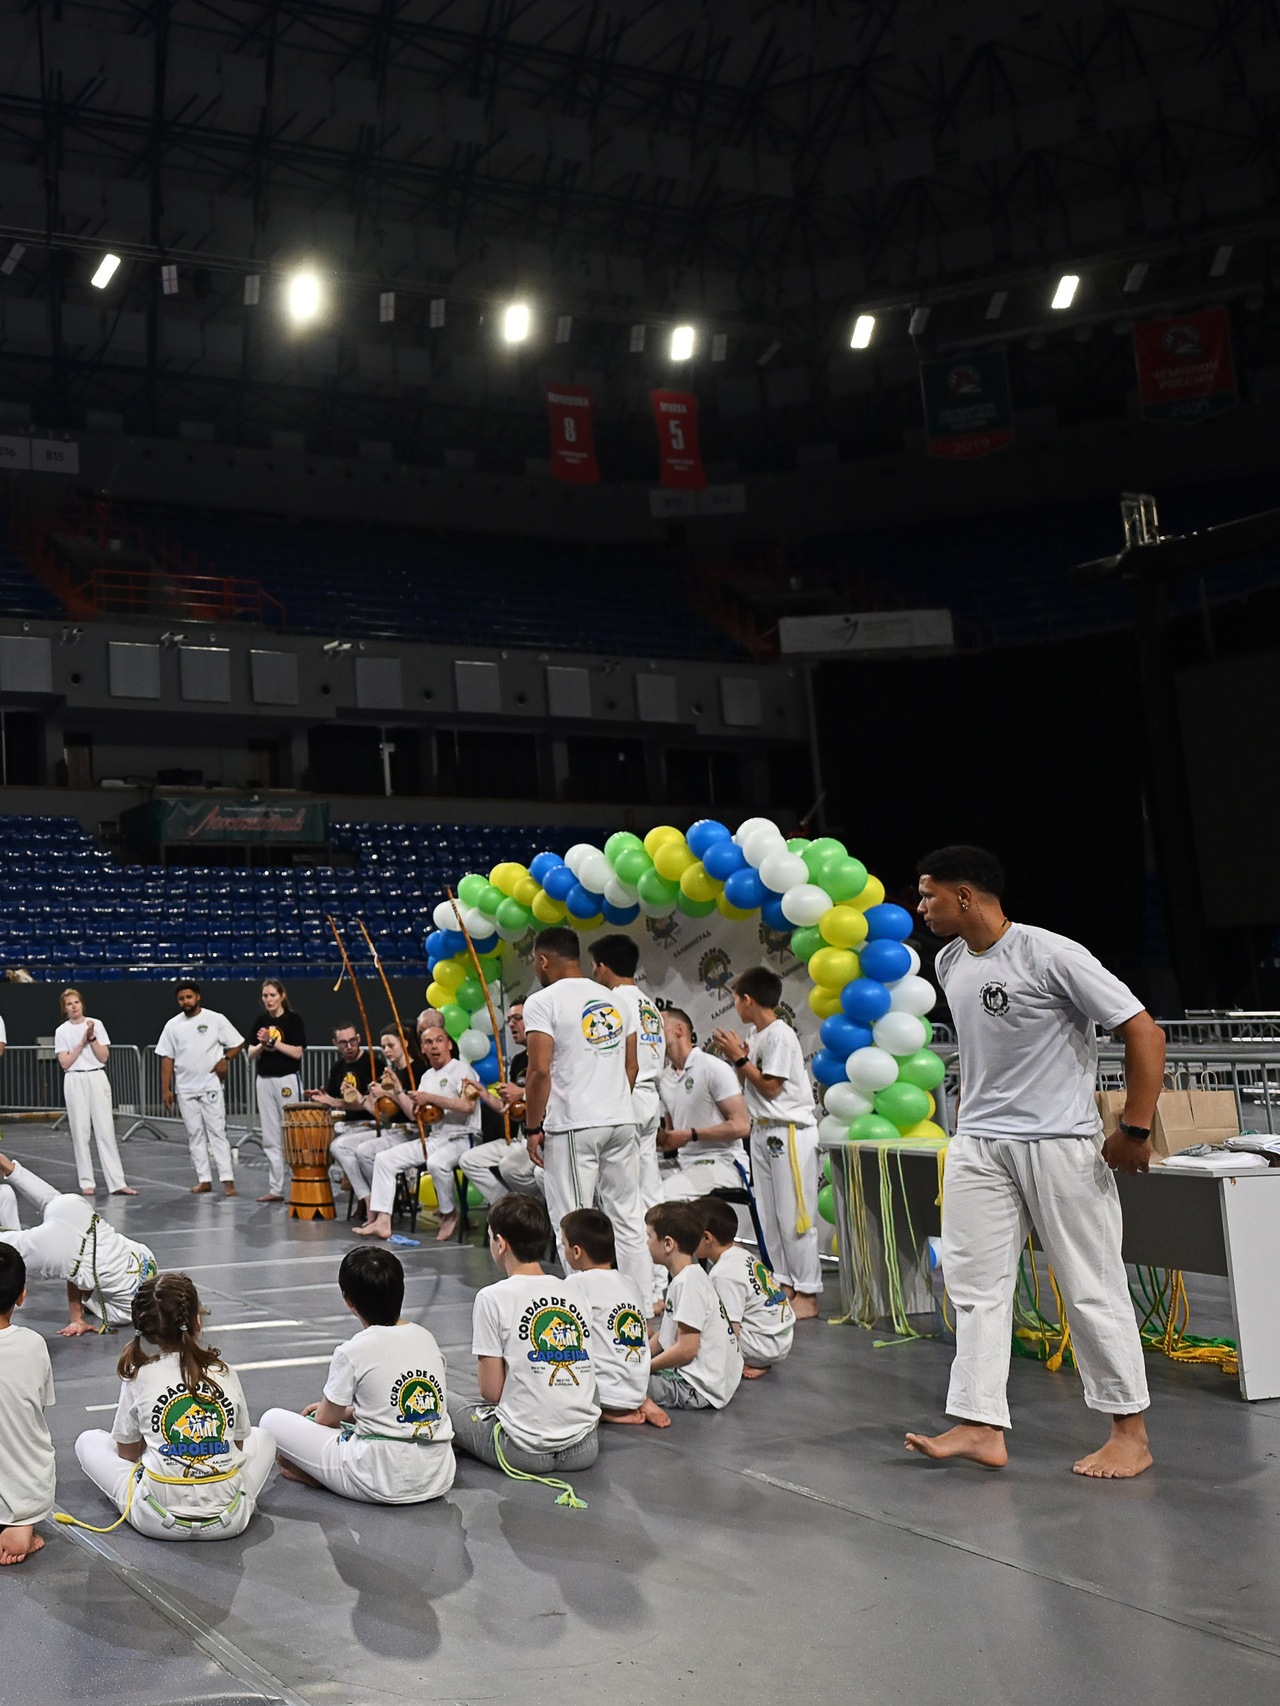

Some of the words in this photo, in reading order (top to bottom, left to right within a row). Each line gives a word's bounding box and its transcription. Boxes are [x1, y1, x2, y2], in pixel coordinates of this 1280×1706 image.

[563, 417, 577, 442] 8
[669, 419, 685, 450] 5
[551, 1296, 567, 1308] DE
[527, 1348, 590, 1362] CAPOEIRA
[416, 1369, 428, 1378] DE
[429, 1374, 444, 1402] OURO
[151, 1383, 187, 1433] CORDÃO
[158, 1439, 230, 1457] CAPOEIRA
